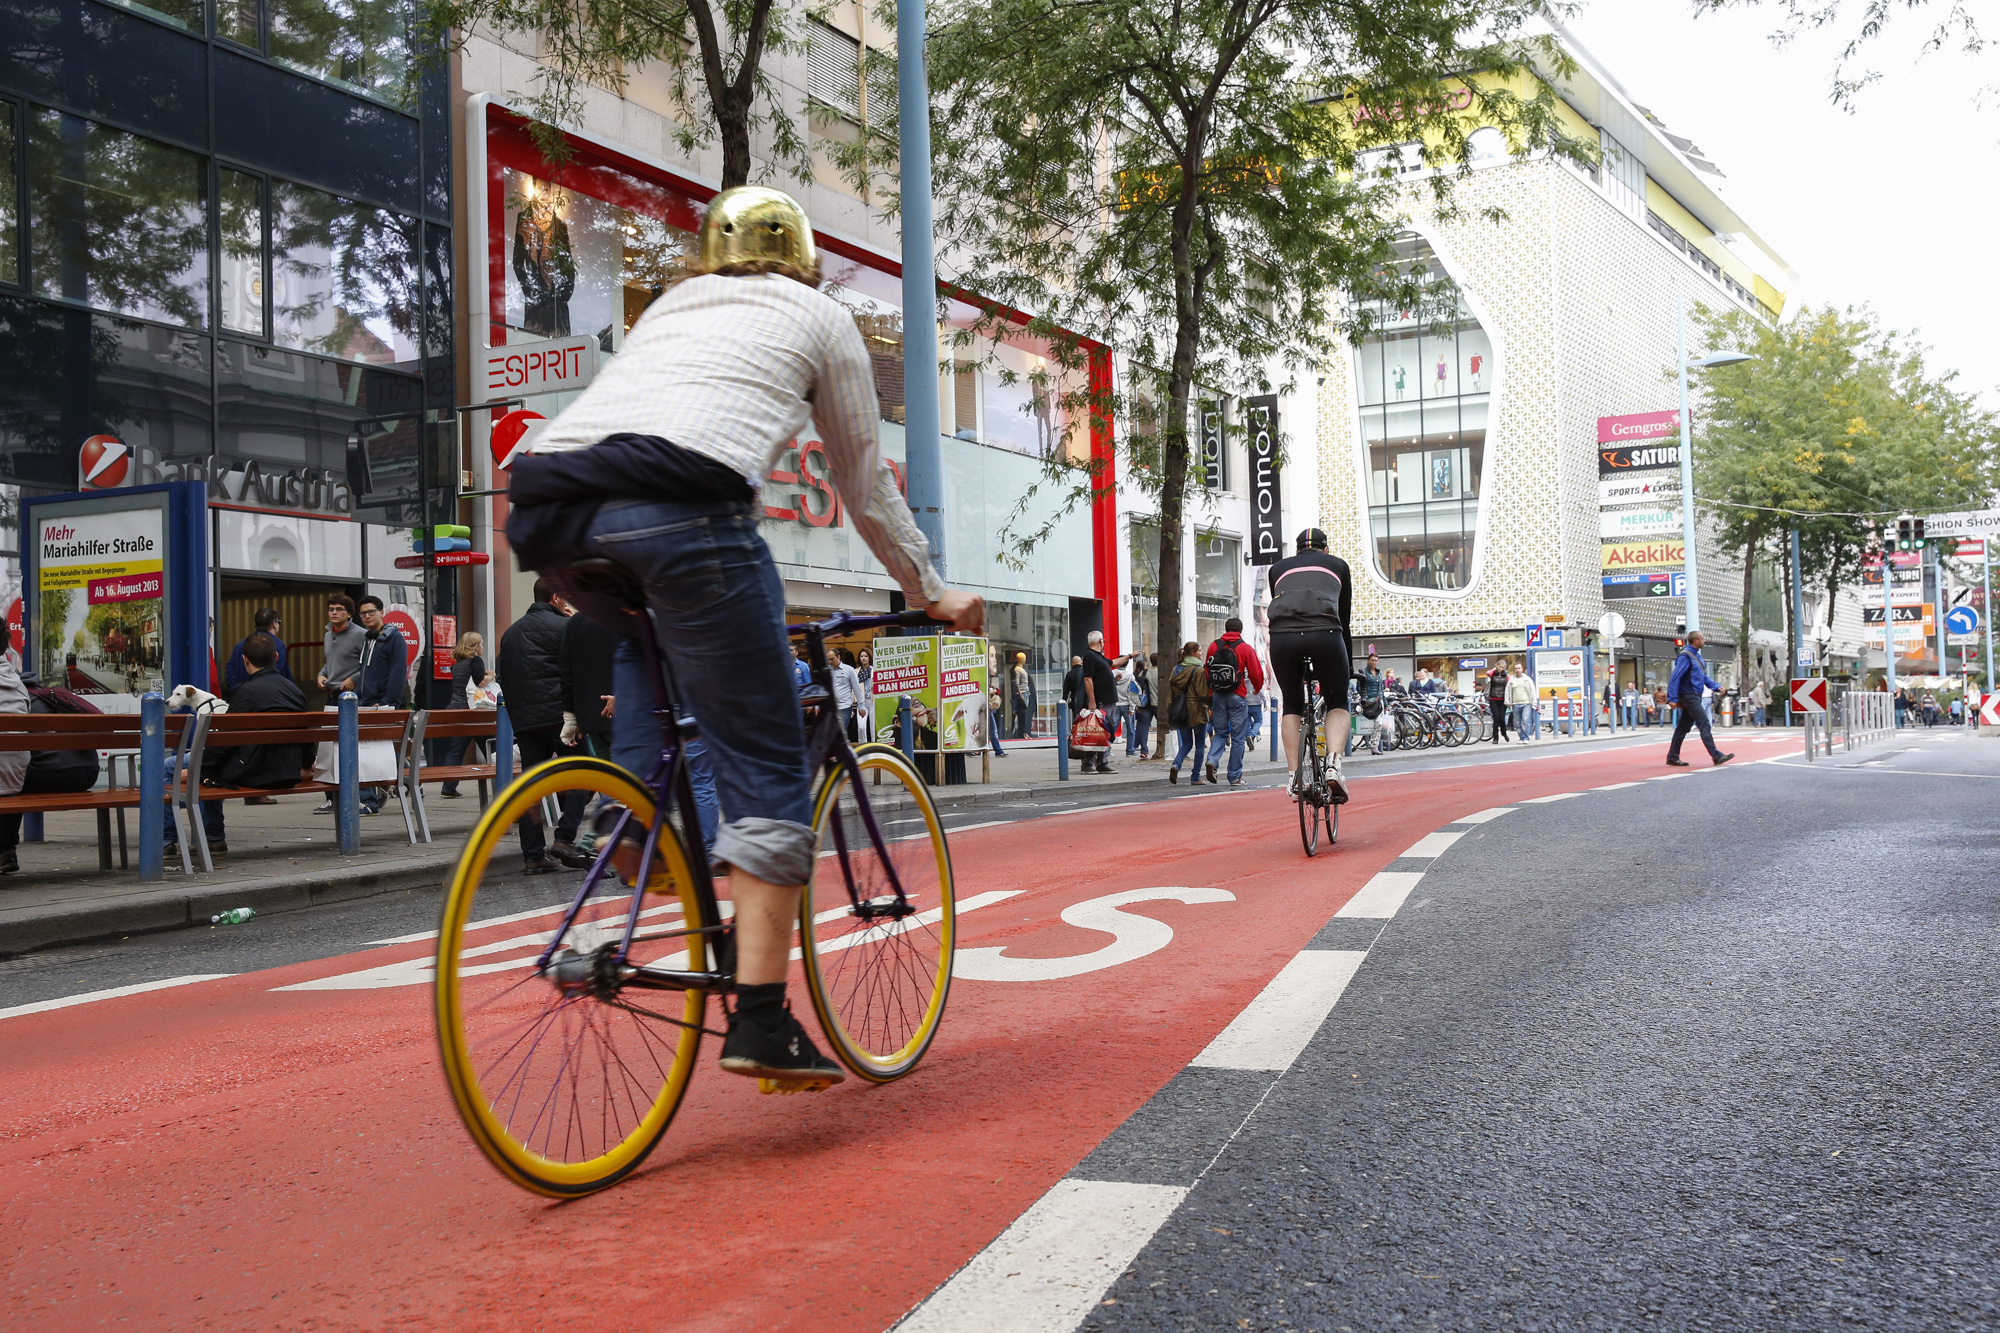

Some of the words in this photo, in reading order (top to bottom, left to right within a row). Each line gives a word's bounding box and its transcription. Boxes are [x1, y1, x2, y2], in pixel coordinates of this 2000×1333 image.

[488, 345, 586, 389] ESPRIT
[1611, 422, 1673, 436] Gerngross
[1631, 446, 1682, 467] SATUR
[134, 443, 232, 500] Bank
[238, 459, 352, 514] Austria
[1250, 405, 1279, 555] promod
[1608, 486, 1640, 497] SPORTS
[1620, 512, 1674, 525] MERKUR
[1924, 520, 1962, 531] SHION
[44, 525, 76, 542] Mehr
[43, 539, 110, 559] Mariahilfer
[113, 535, 154, 554] Straße
[60, 569, 81, 577] Mariahilfer
[82, 568, 94, 576] Straße
[1611, 575, 1640, 584] GARAGE
[94, 585, 104, 598] Ab
[106, 585, 116, 597] 16.
[117, 583, 142, 598] August
[143, 579, 159, 592] 2013
[875, 647, 895, 657] WER
[896, 641, 929, 654] EINMAL
[943, 644, 974, 656] WENIGER
[1463, 641, 1508, 650] PALMERS
[876, 657, 913, 669] STIEHLT,
[944, 656, 984, 670] BELÄMMERT
[877, 669, 896, 681] DEN
[896, 665, 926, 679] WÄHLT
[944, 672, 957, 684] ALS
[957, 670, 969, 682] DIE
[878, 681, 899, 693] MAN
[899, 678, 928, 690] NICHT.
[945, 683, 979, 697] ANDEREN.
